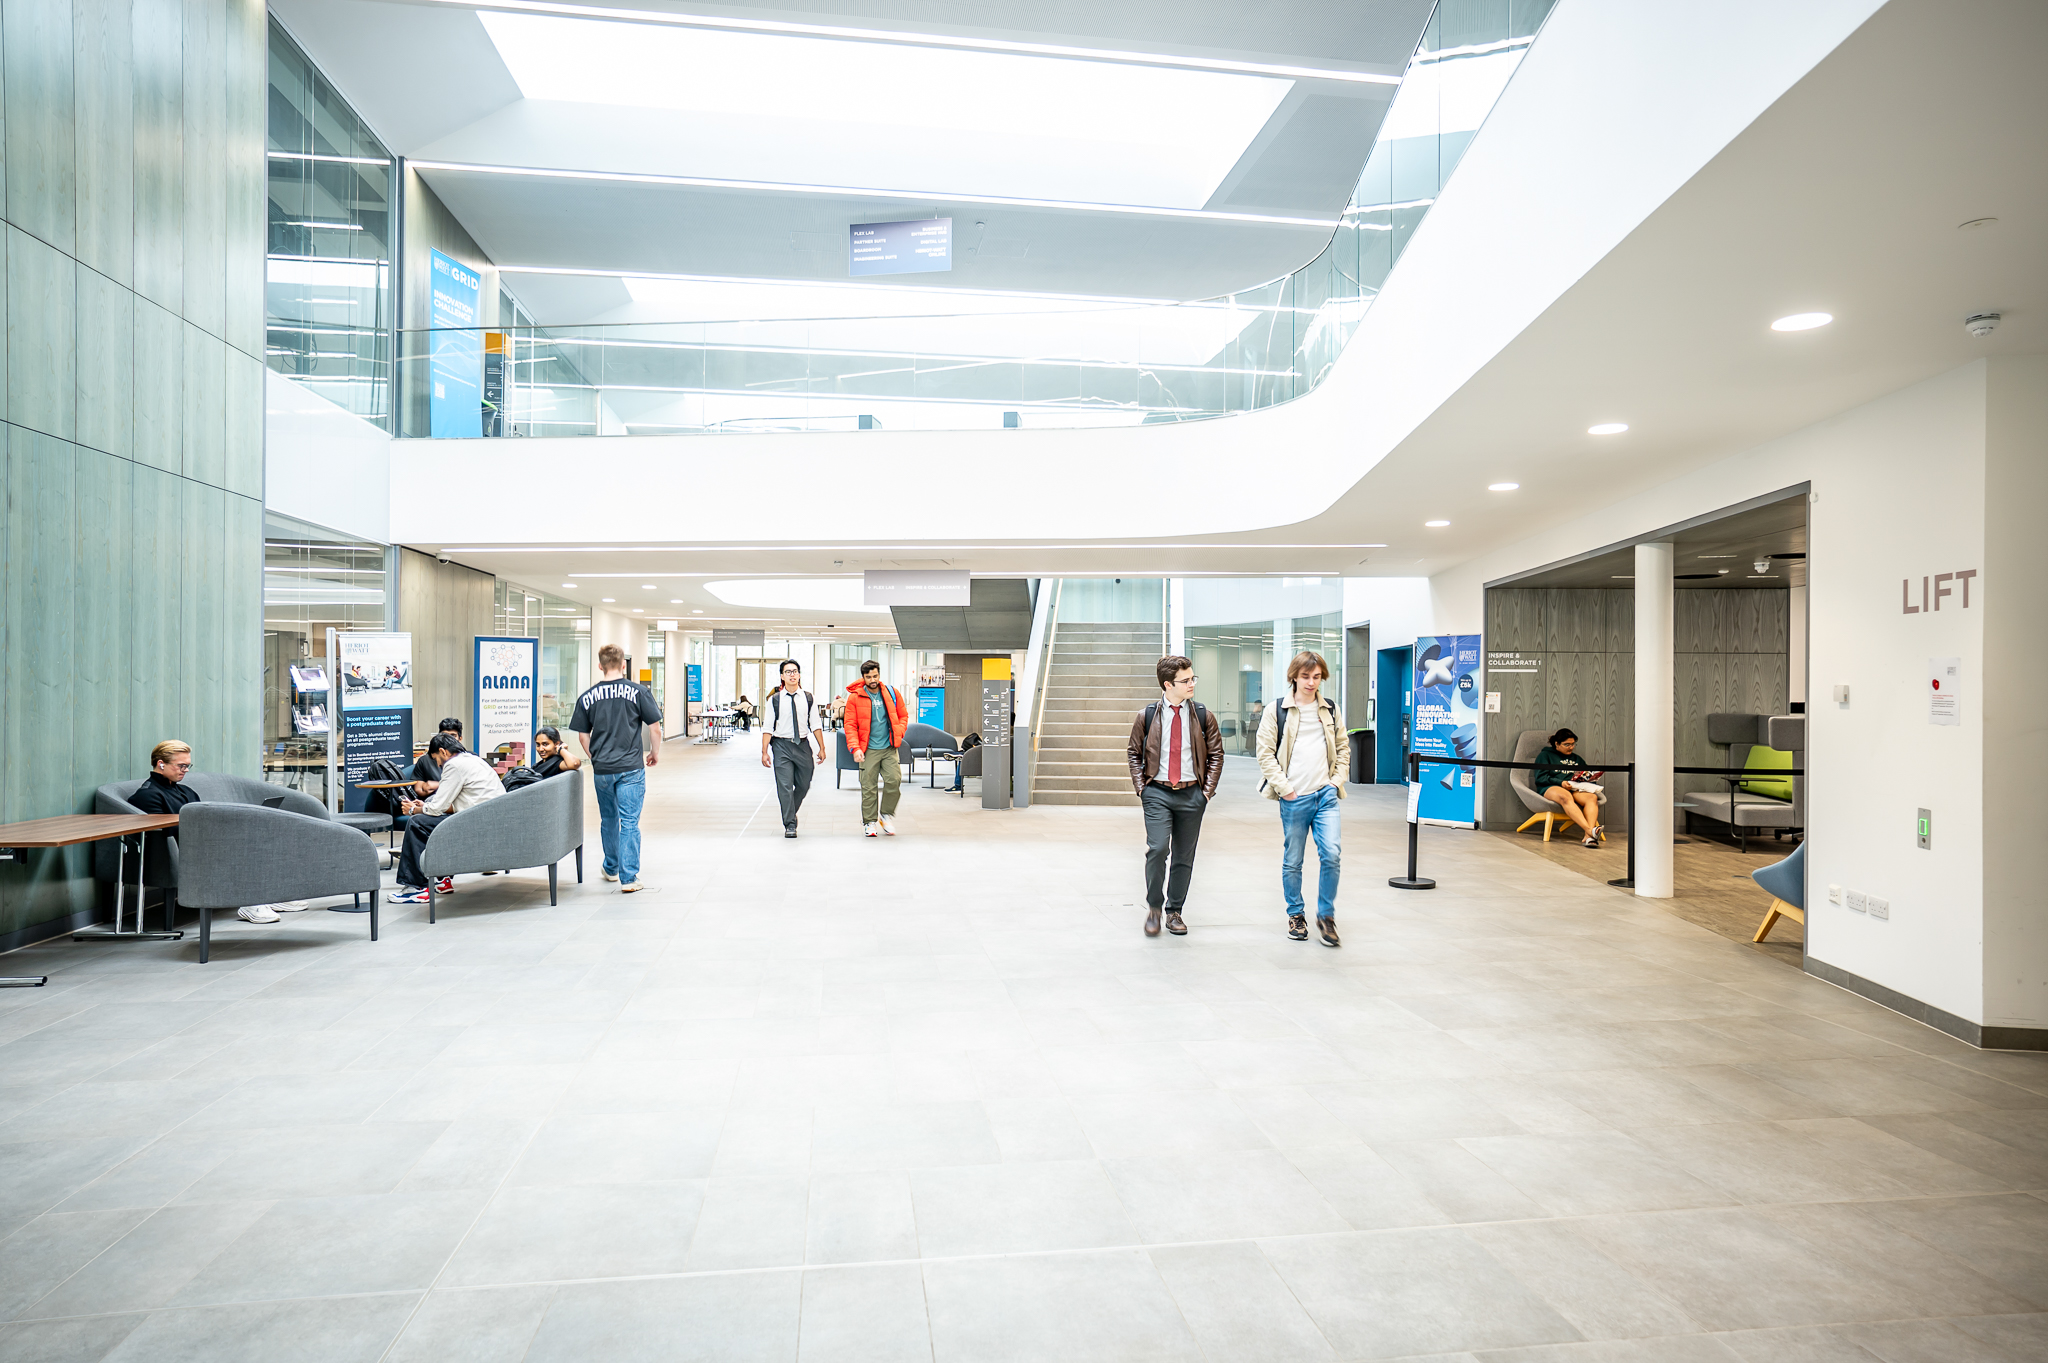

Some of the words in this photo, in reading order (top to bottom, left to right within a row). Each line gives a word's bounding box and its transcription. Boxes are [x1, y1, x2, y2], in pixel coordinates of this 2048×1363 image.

[452, 267, 478, 290] GRID
[434, 289, 473, 315] INNOVATION
[434, 299, 472, 323] CHALLENGE
[1903, 569, 1976, 614] LIFT
[483, 676, 530, 689] ALANA
[582, 683, 639, 710] GYMTHARK
